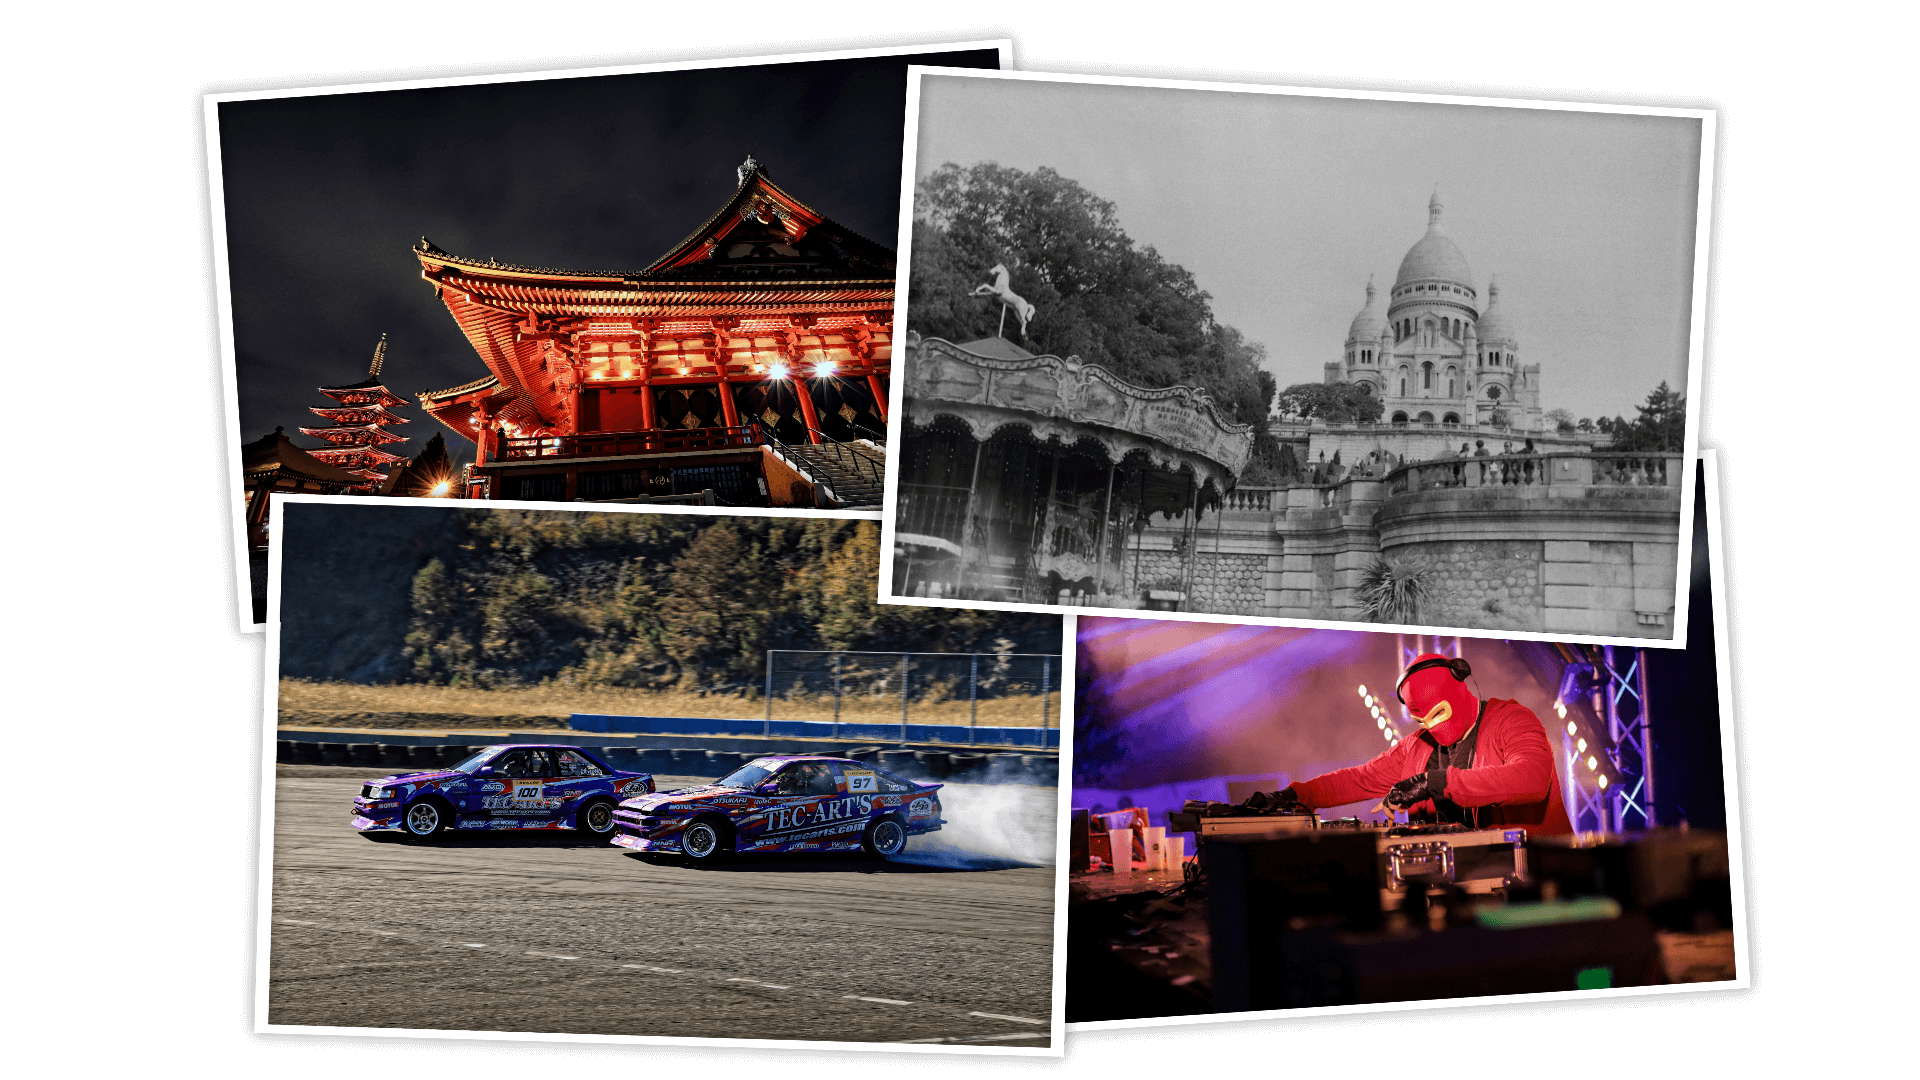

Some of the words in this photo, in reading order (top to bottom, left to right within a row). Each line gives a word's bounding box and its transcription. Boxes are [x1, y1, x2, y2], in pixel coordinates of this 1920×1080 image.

[517, 787, 539, 798] 100
[852, 777, 871, 789] 97
[763, 794, 873, 833] TEC-ART'S
[754, 820, 867, 848] www.tecarts.com
